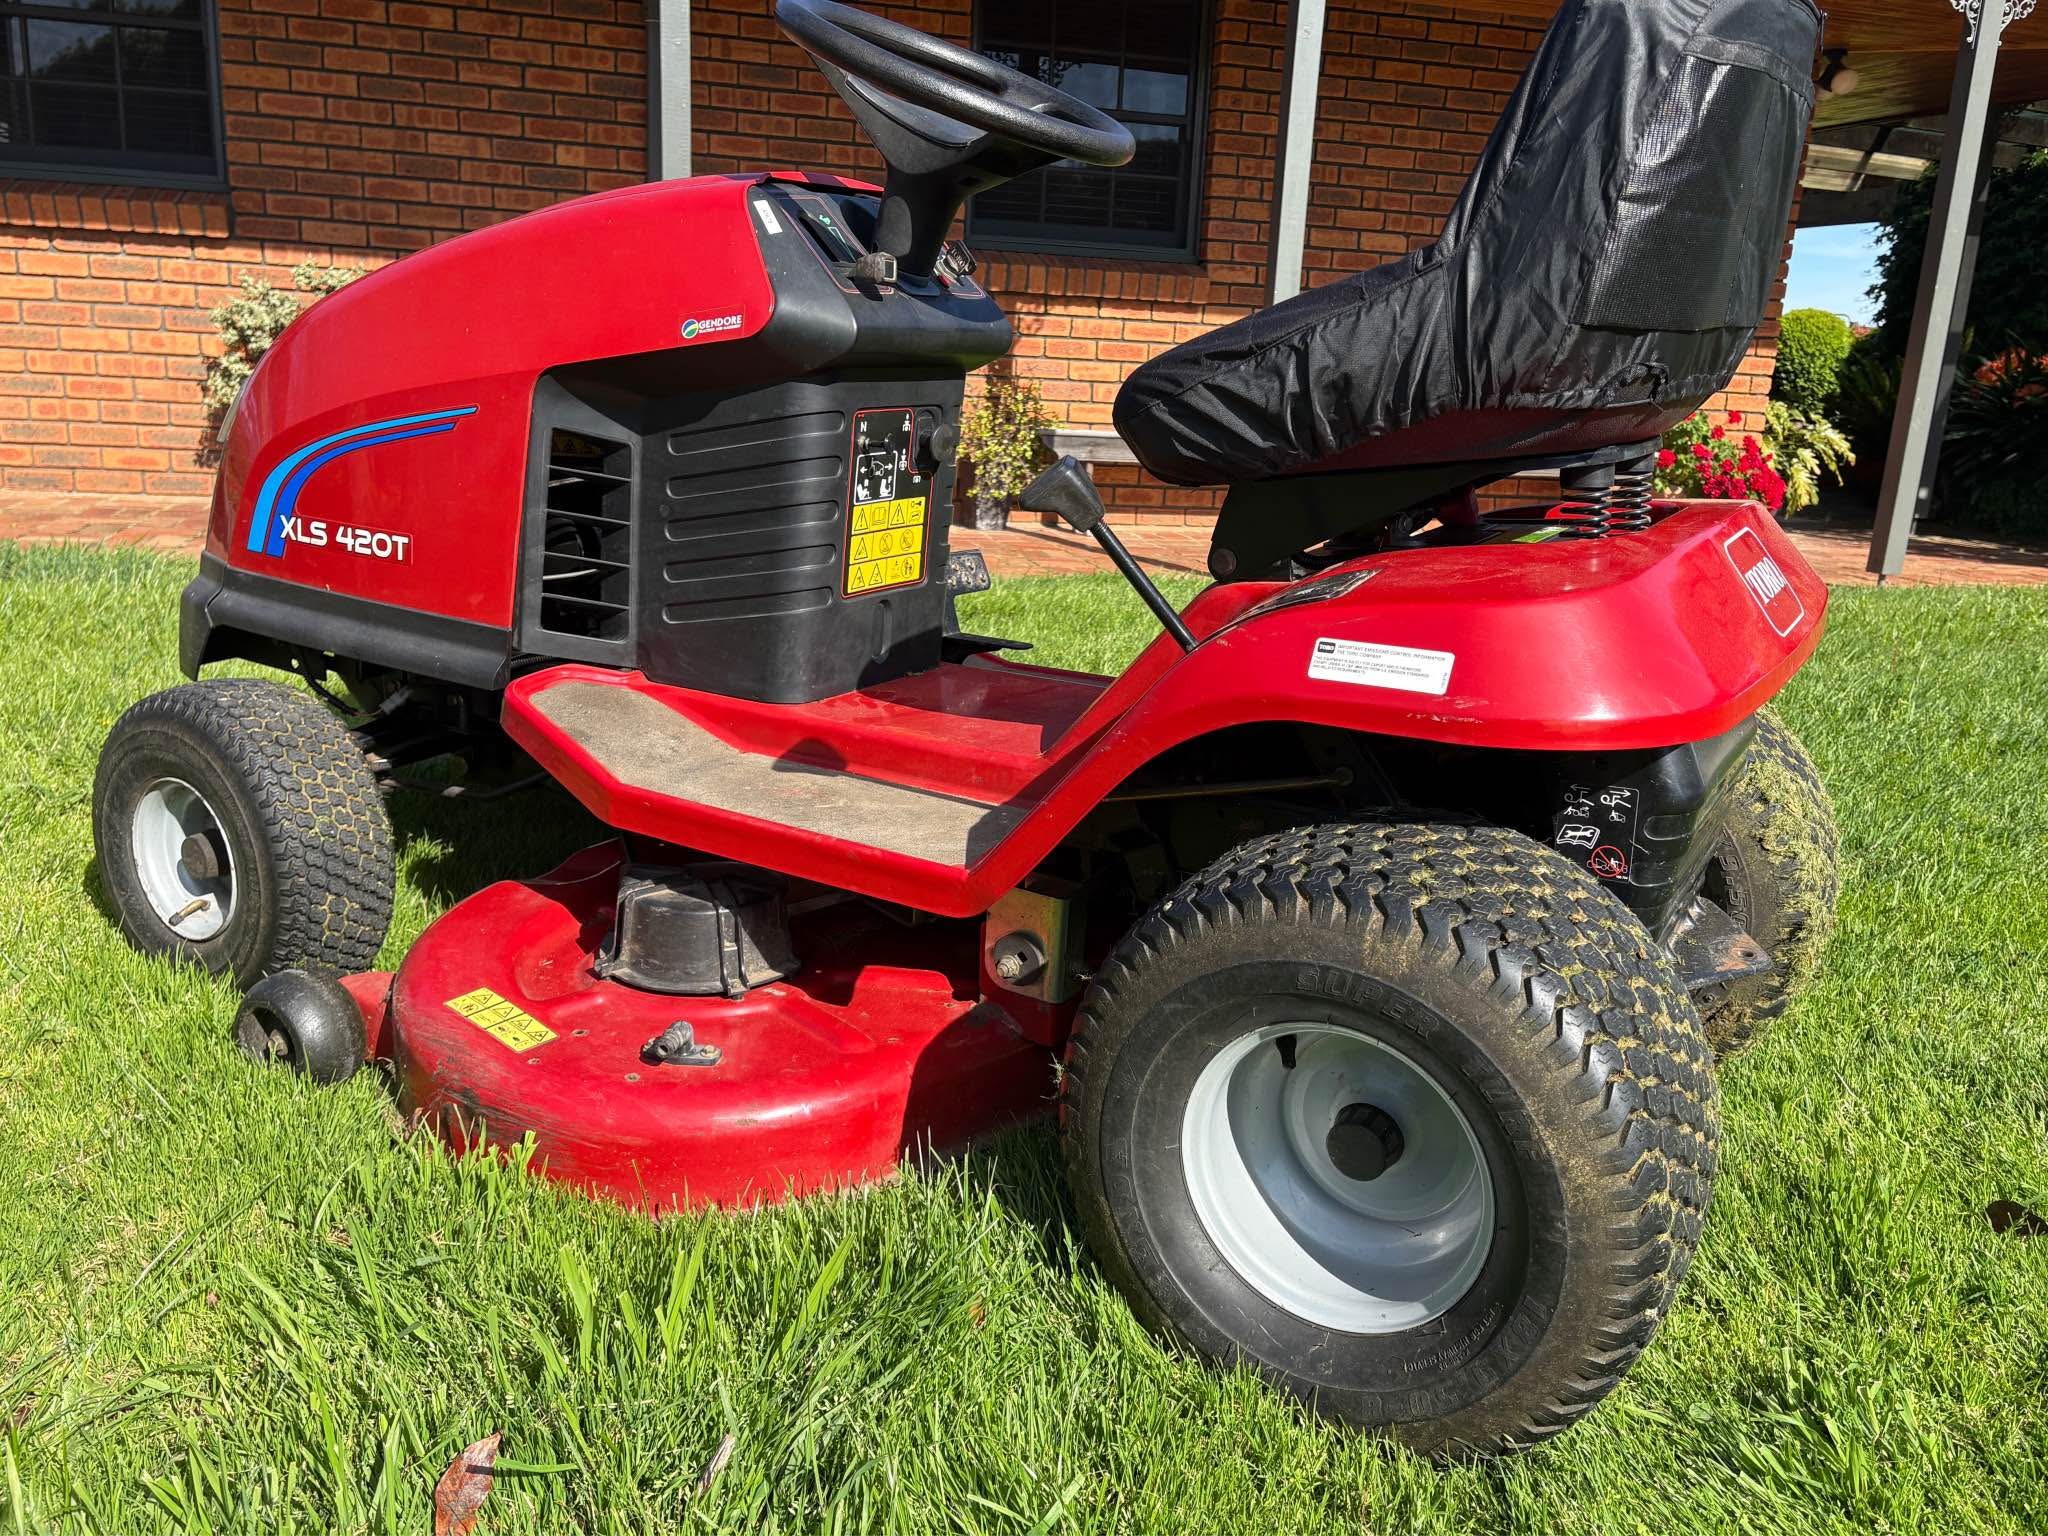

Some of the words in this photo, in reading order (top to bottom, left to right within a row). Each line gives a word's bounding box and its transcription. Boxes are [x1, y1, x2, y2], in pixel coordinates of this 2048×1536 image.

[698, 314, 743, 330] GENDORE
[860, 421, 867, 432] N
[280, 514, 328, 547] XLS
[335, 525, 409, 561] 420T
[1744, 556, 1786, 605] TORO
[1296, 966, 1441, 1041] SUPER
